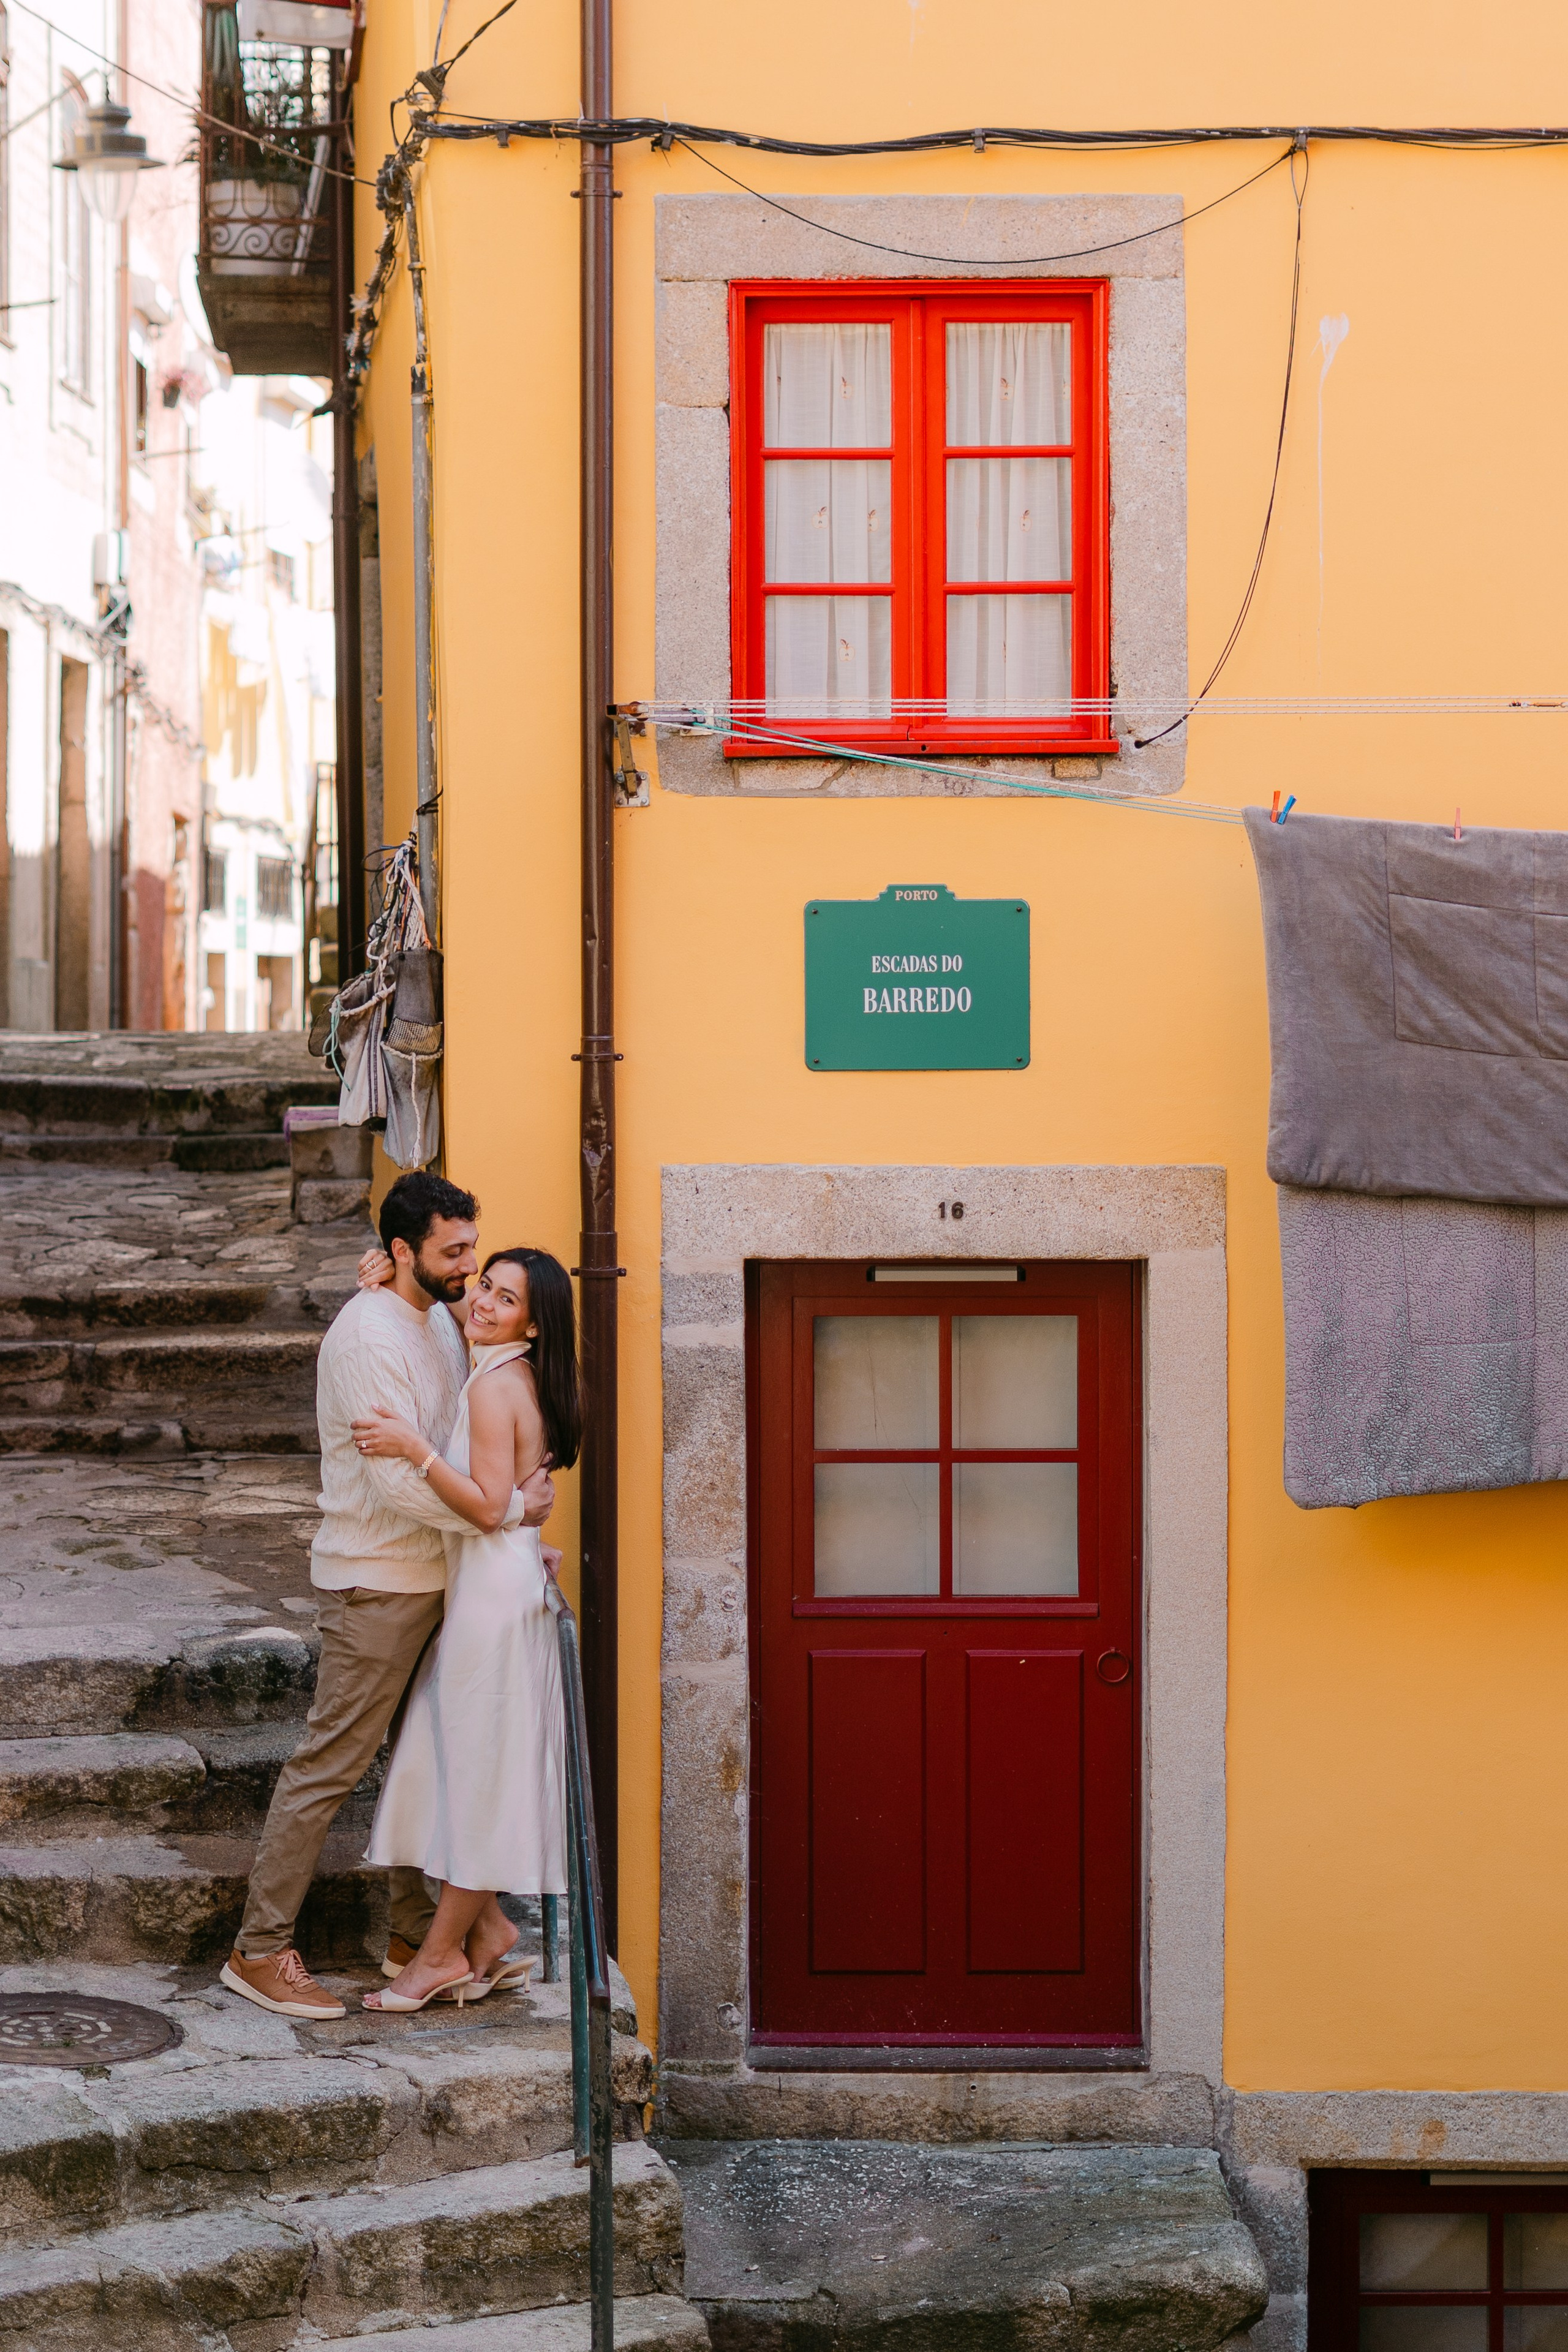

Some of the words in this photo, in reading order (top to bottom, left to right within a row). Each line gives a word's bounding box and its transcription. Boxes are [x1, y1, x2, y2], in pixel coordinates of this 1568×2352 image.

[895, 890, 938, 900] PORTO
[872, 955, 938, 973] ESCADAS
[941, 954, 962, 972] DO
[863, 986, 972, 1013] BARREDO
[938, 1201, 964, 1219] 16
